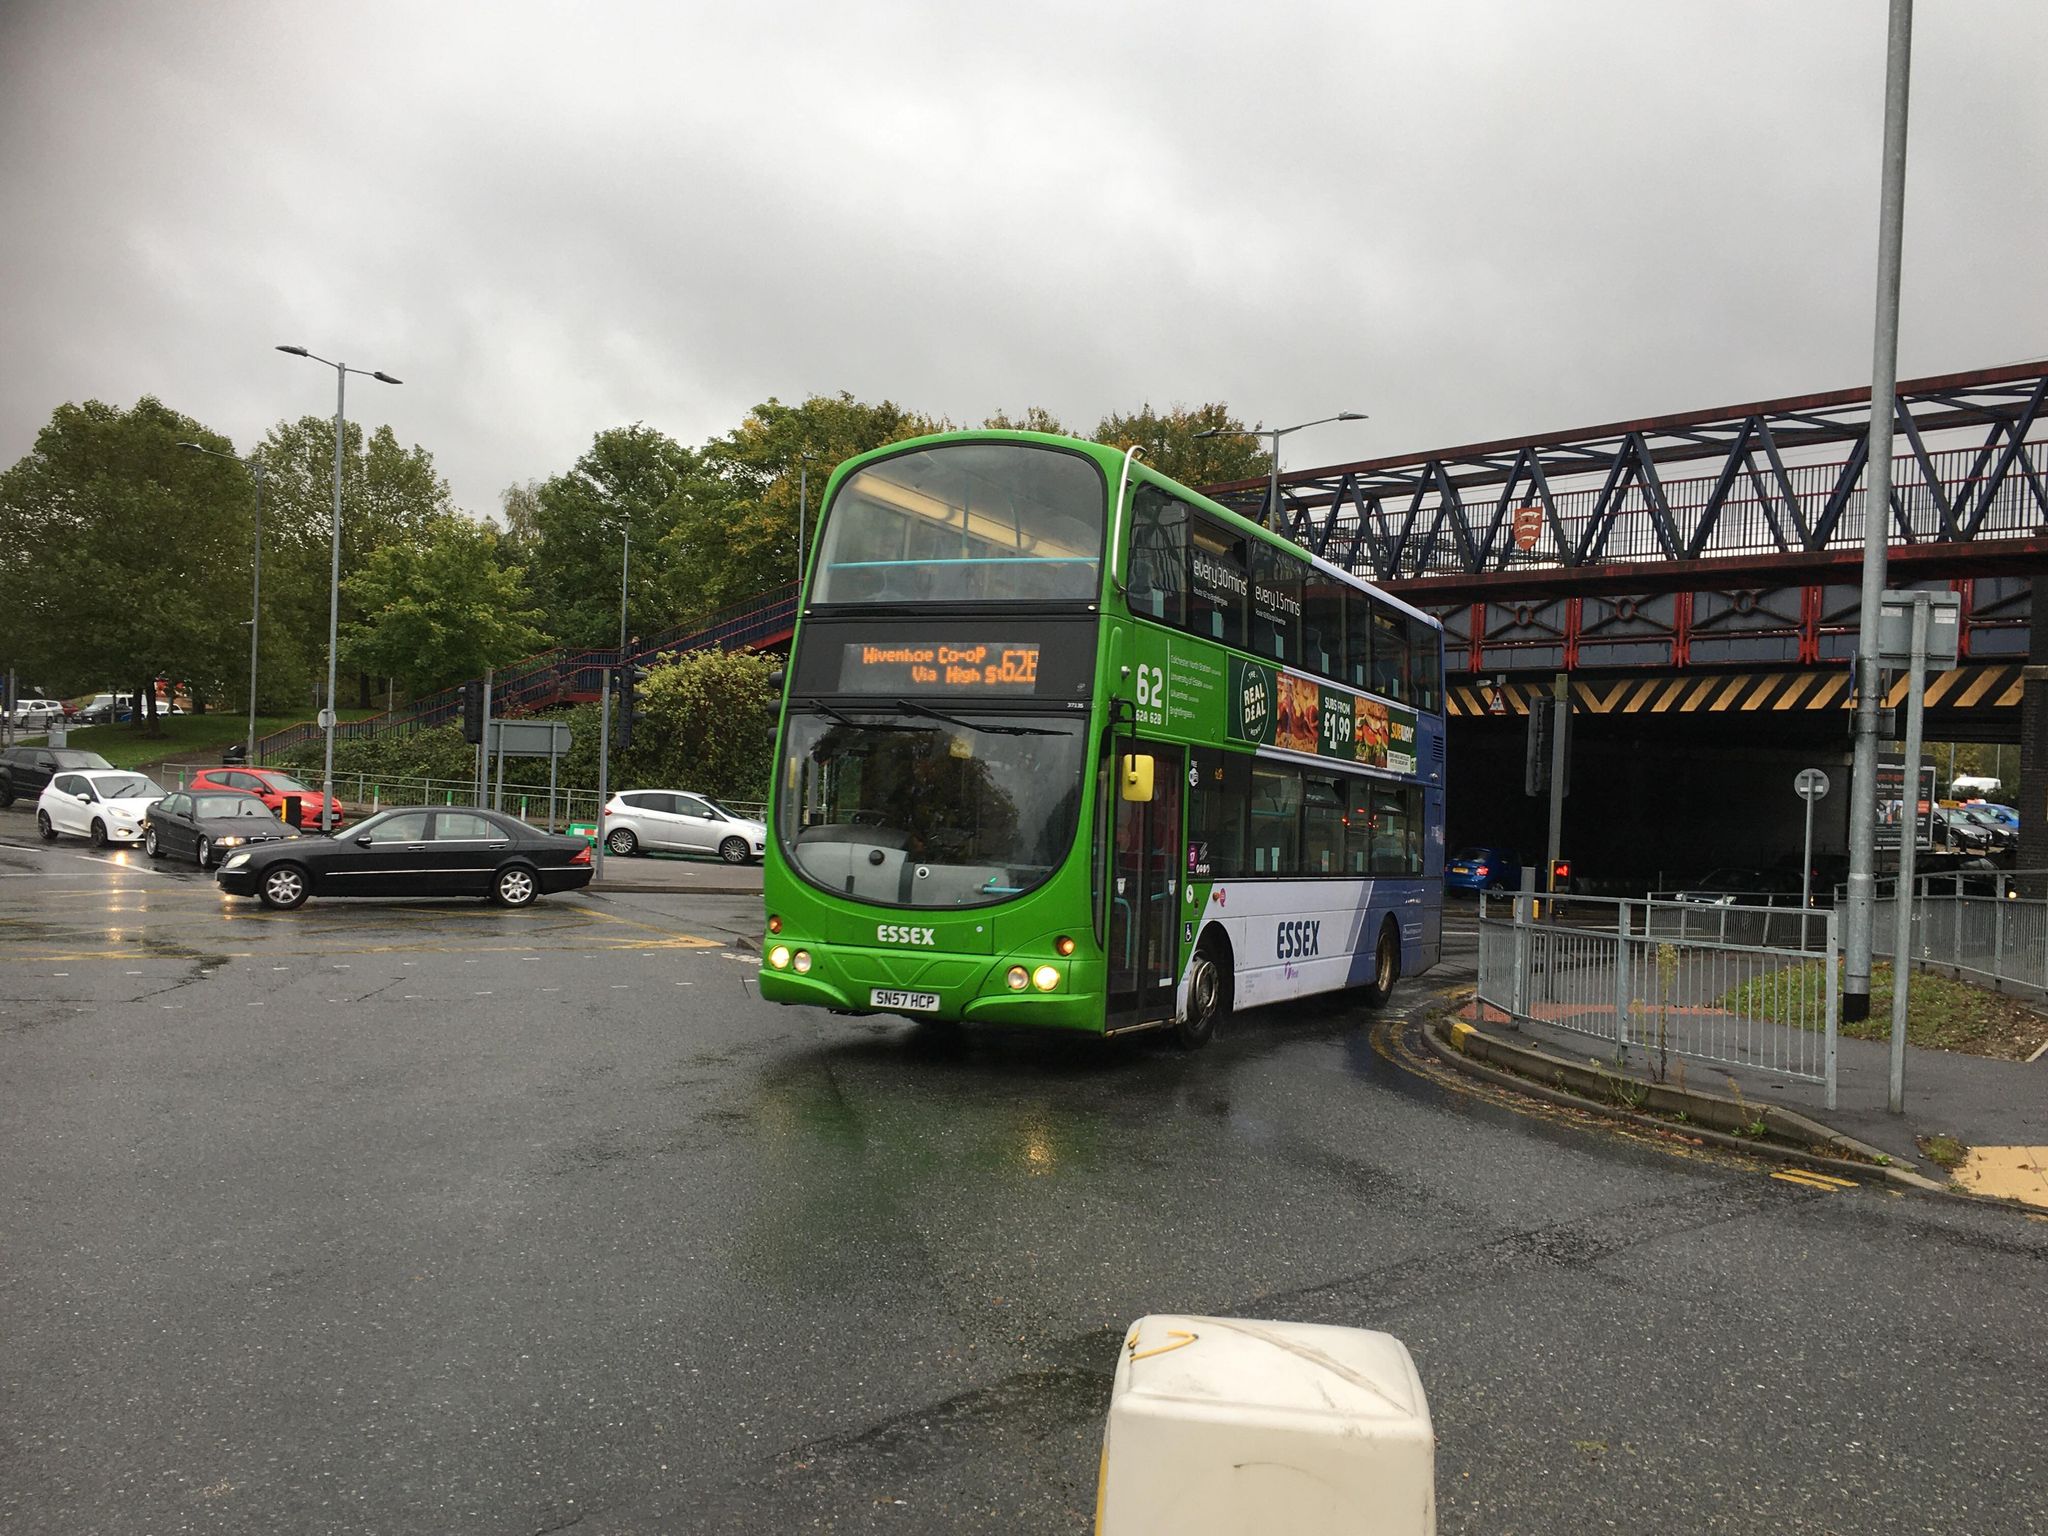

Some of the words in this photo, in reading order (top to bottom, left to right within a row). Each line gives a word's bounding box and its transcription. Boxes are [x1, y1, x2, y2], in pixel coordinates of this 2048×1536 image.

[862, 646, 934, 664] Wivenhoe
[912, 665, 937, 683] Via
[945, 665, 981, 684] High
[1136, 663, 1163, 708] 62
[1243, 682, 1265, 706] REAL
[1324, 696, 1337, 711] SUBS
[1337, 700, 1351, 715] FROM
[1135, 709, 1149, 722] 62A
[1149, 712, 1162, 725] 62B
[1323, 711, 1351, 750] £1.99
[1390, 722, 1414, 744] SUBWAY
[877, 924, 935, 946] ESSEX
[1276, 920, 1321, 959] ESSEX
[876, 991, 908, 1007] SN57
[910, 994, 935, 1009] HCP
